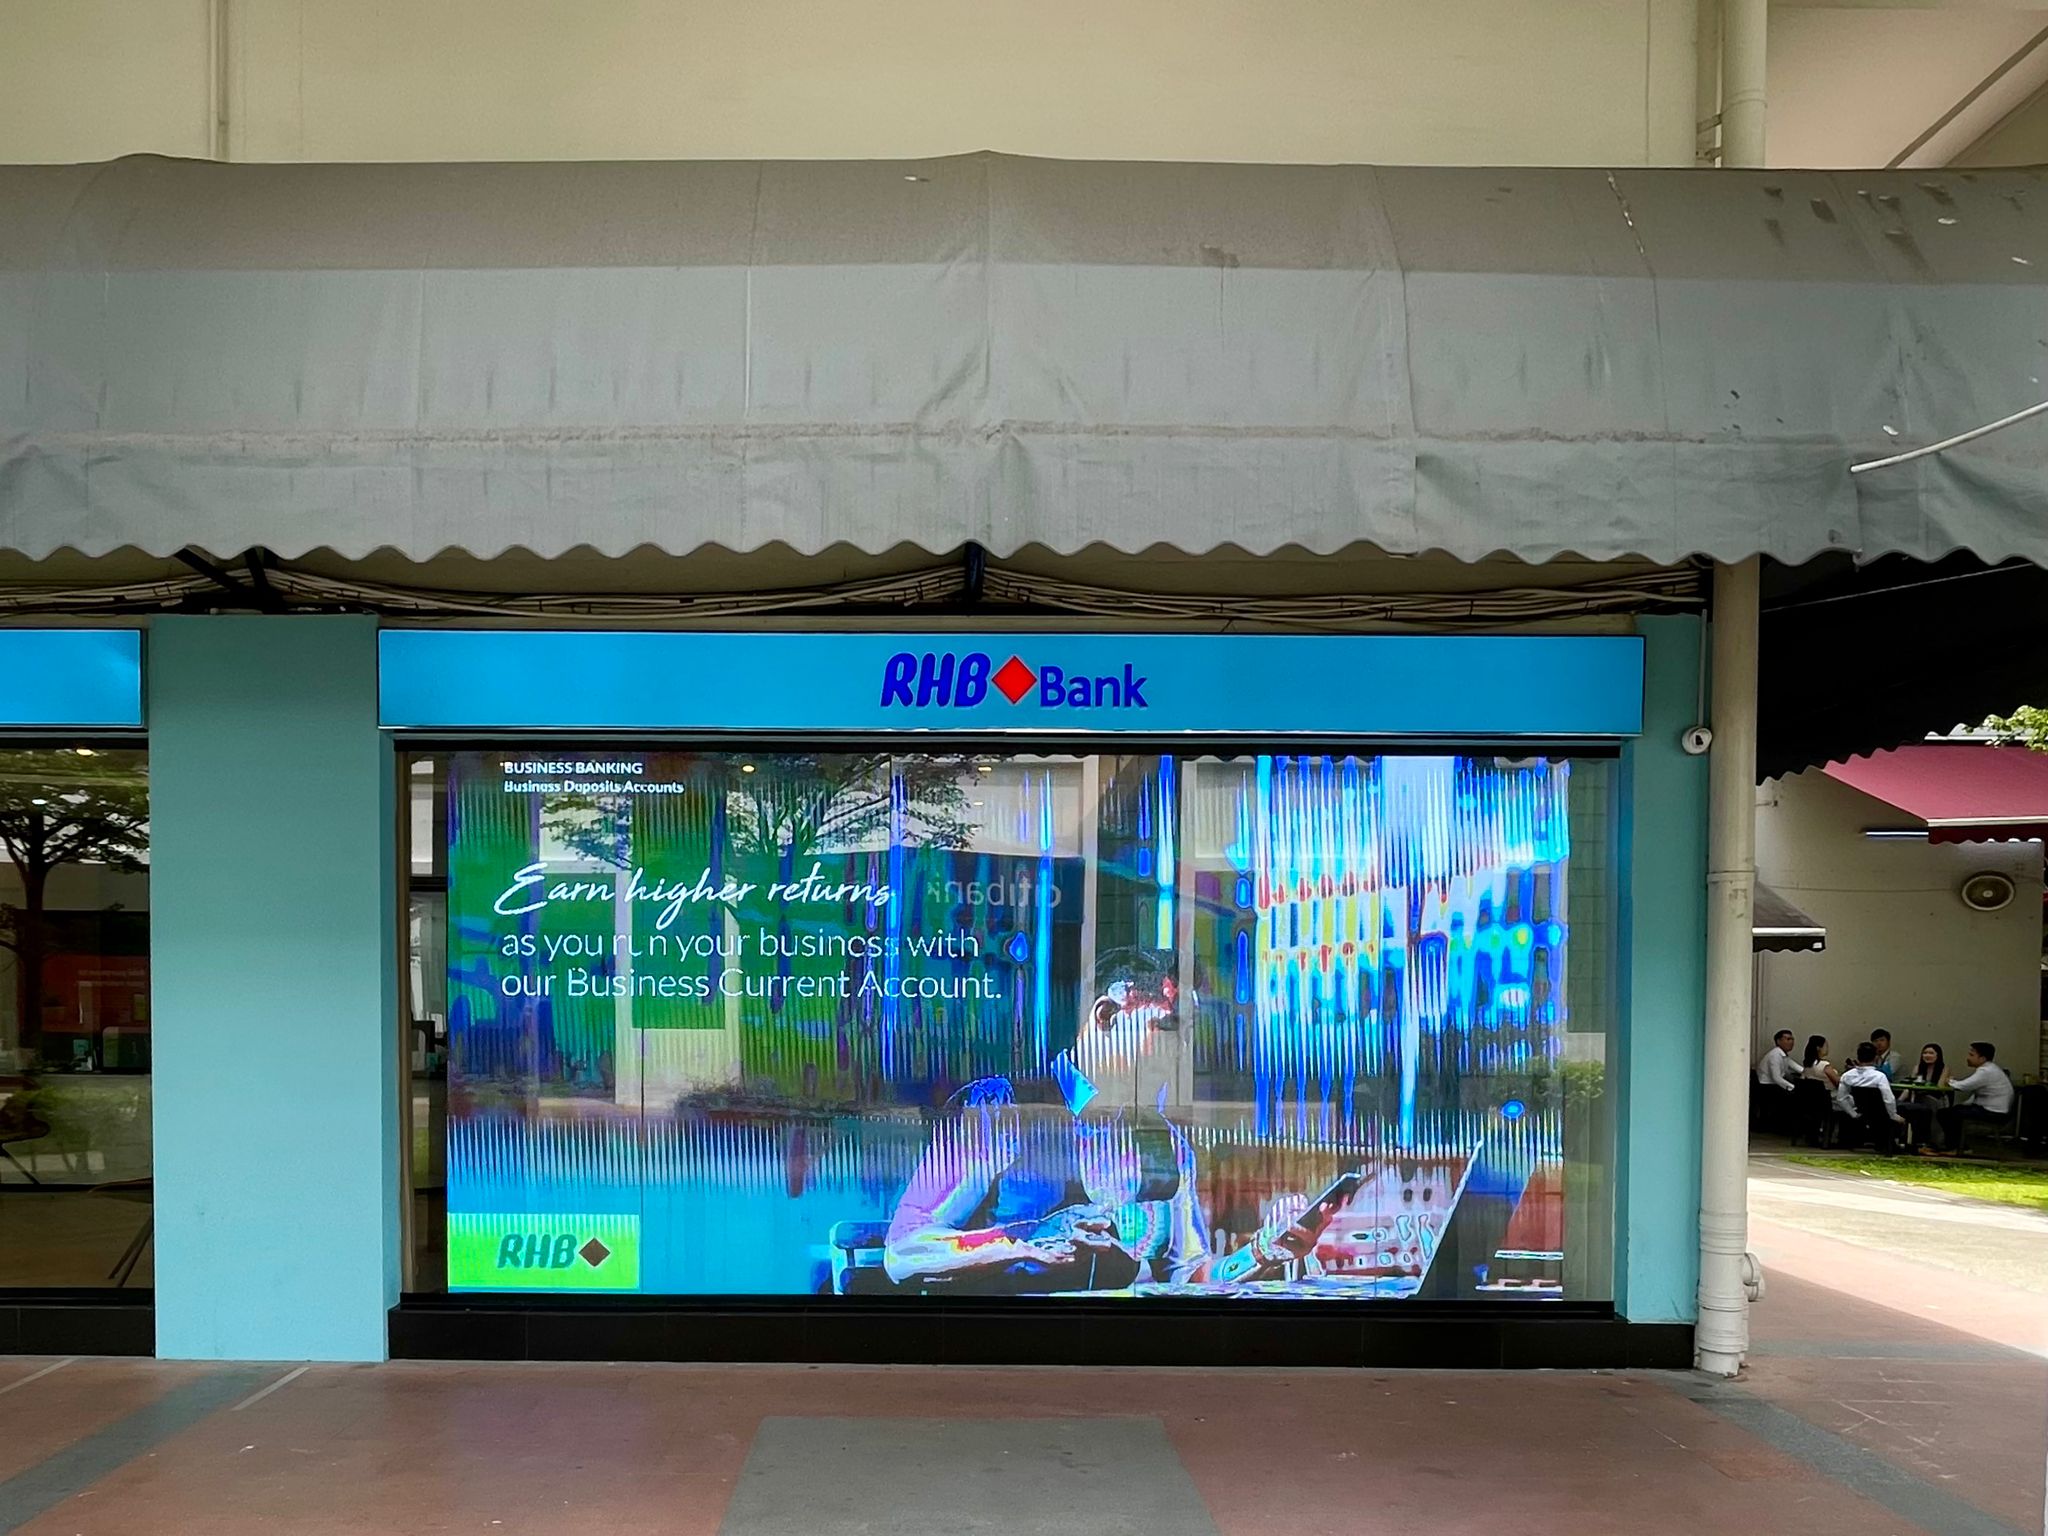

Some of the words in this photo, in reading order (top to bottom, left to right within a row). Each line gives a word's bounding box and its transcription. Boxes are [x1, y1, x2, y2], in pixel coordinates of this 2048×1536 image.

[880, 652, 991, 708] RHB
[1040, 663, 1148, 708] Bank
[504, 762, 572, 774] BUSINESS
[575, 762, 643, 774] BANKING
[504, 780, 561, 792] Business
[564, 780, 622, 794] Deposits
[622, 780, 684, 793] Accounts
[493, 862, 615, 915] Earn
[624, 868, 757, 930] higher
[767, 861, 892, 906] returns
[502, 934, 536, 956] as
[545, 934, 602, 962] you
[674, 934, 750, 962] your
[760, 928, 898, 957] business
[907, 928, 979, 957] with
[502, 974, 556, 996] our
[567, 968, 710, 997] Business
[719, 968, 854, 998] Current
[858, 970, 1001, 999] Account.
[497, 1233, 577, 1269] RHB
